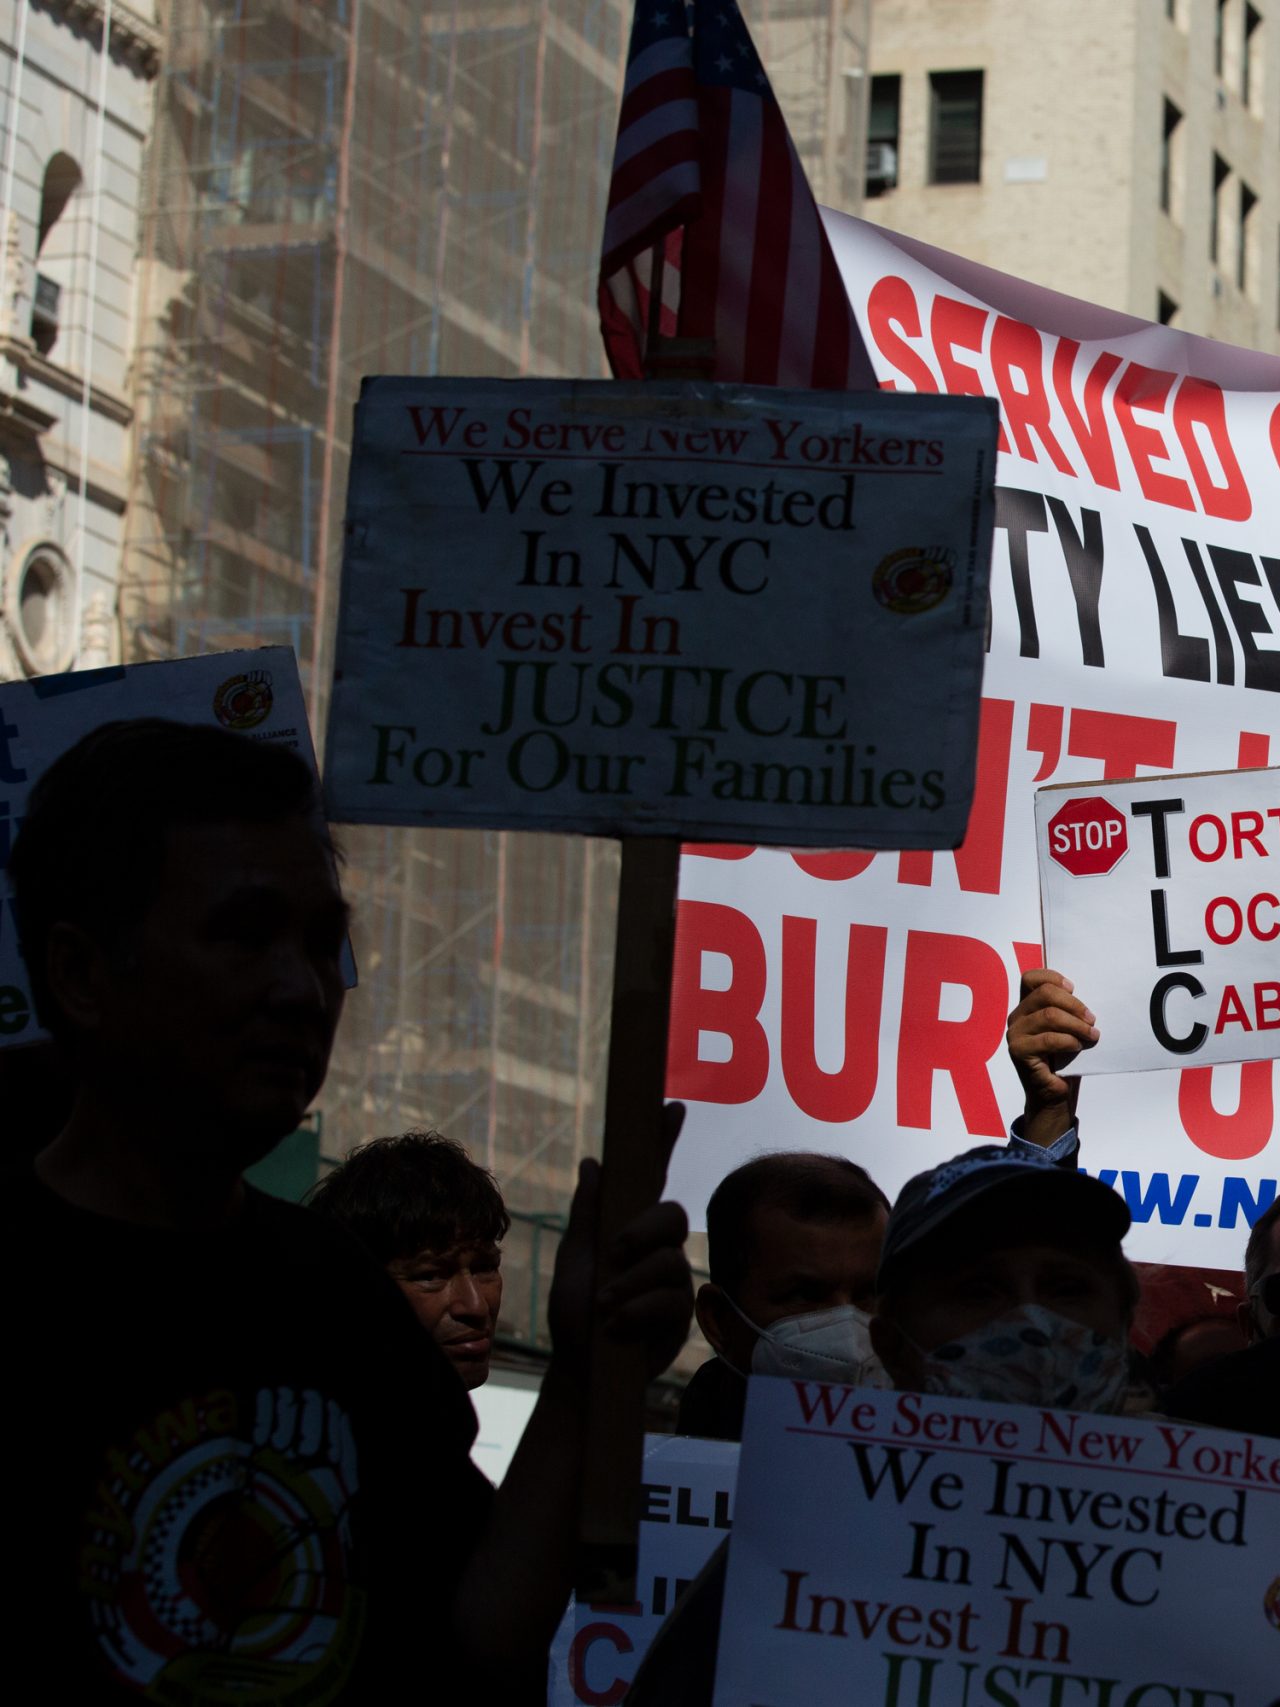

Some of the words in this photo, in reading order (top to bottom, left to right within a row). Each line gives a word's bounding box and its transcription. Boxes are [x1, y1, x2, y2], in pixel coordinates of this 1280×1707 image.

[407, 405, 486, 450] We
[503, 408, 626, 453] Serve
[764, 418, 944, 467] Yorkers
[867, 275, 1252, 522] SERVED
[462, 458, 573, 518] We
[595, 462, 856, 531] Invested
[516, 530, 581, 588] In
[605, 533, 770, 595] NYC
[985, 485, 1105, 668] TY
[397, 587, 592, 653] Invest
[610, 595, 682, 656] In
[481, 659, 848, 739] JUSTICE
[366, 724, 485, 788] For
[508, 730, 645, 796] Our
[668, 735, 946, 812] Families
[1053, 819, 1123, 853] STOP
[664, 899, 1047, 1139] BUR
[792, 1380, 876, 1433] We
[893, 1393, 1018, 1450] Serve
[1035, 1411, 1144, 1464] New
[848, 1441, 963, 1511] We
[985, 1458, 1247, 1546] Invested
[903, 1521, 972, 1585] In
[994, 1532, 1162, 1606] NYC
[774, 1569, 981, 1653] Invest
[998, 1596, 1071, 1663] In
